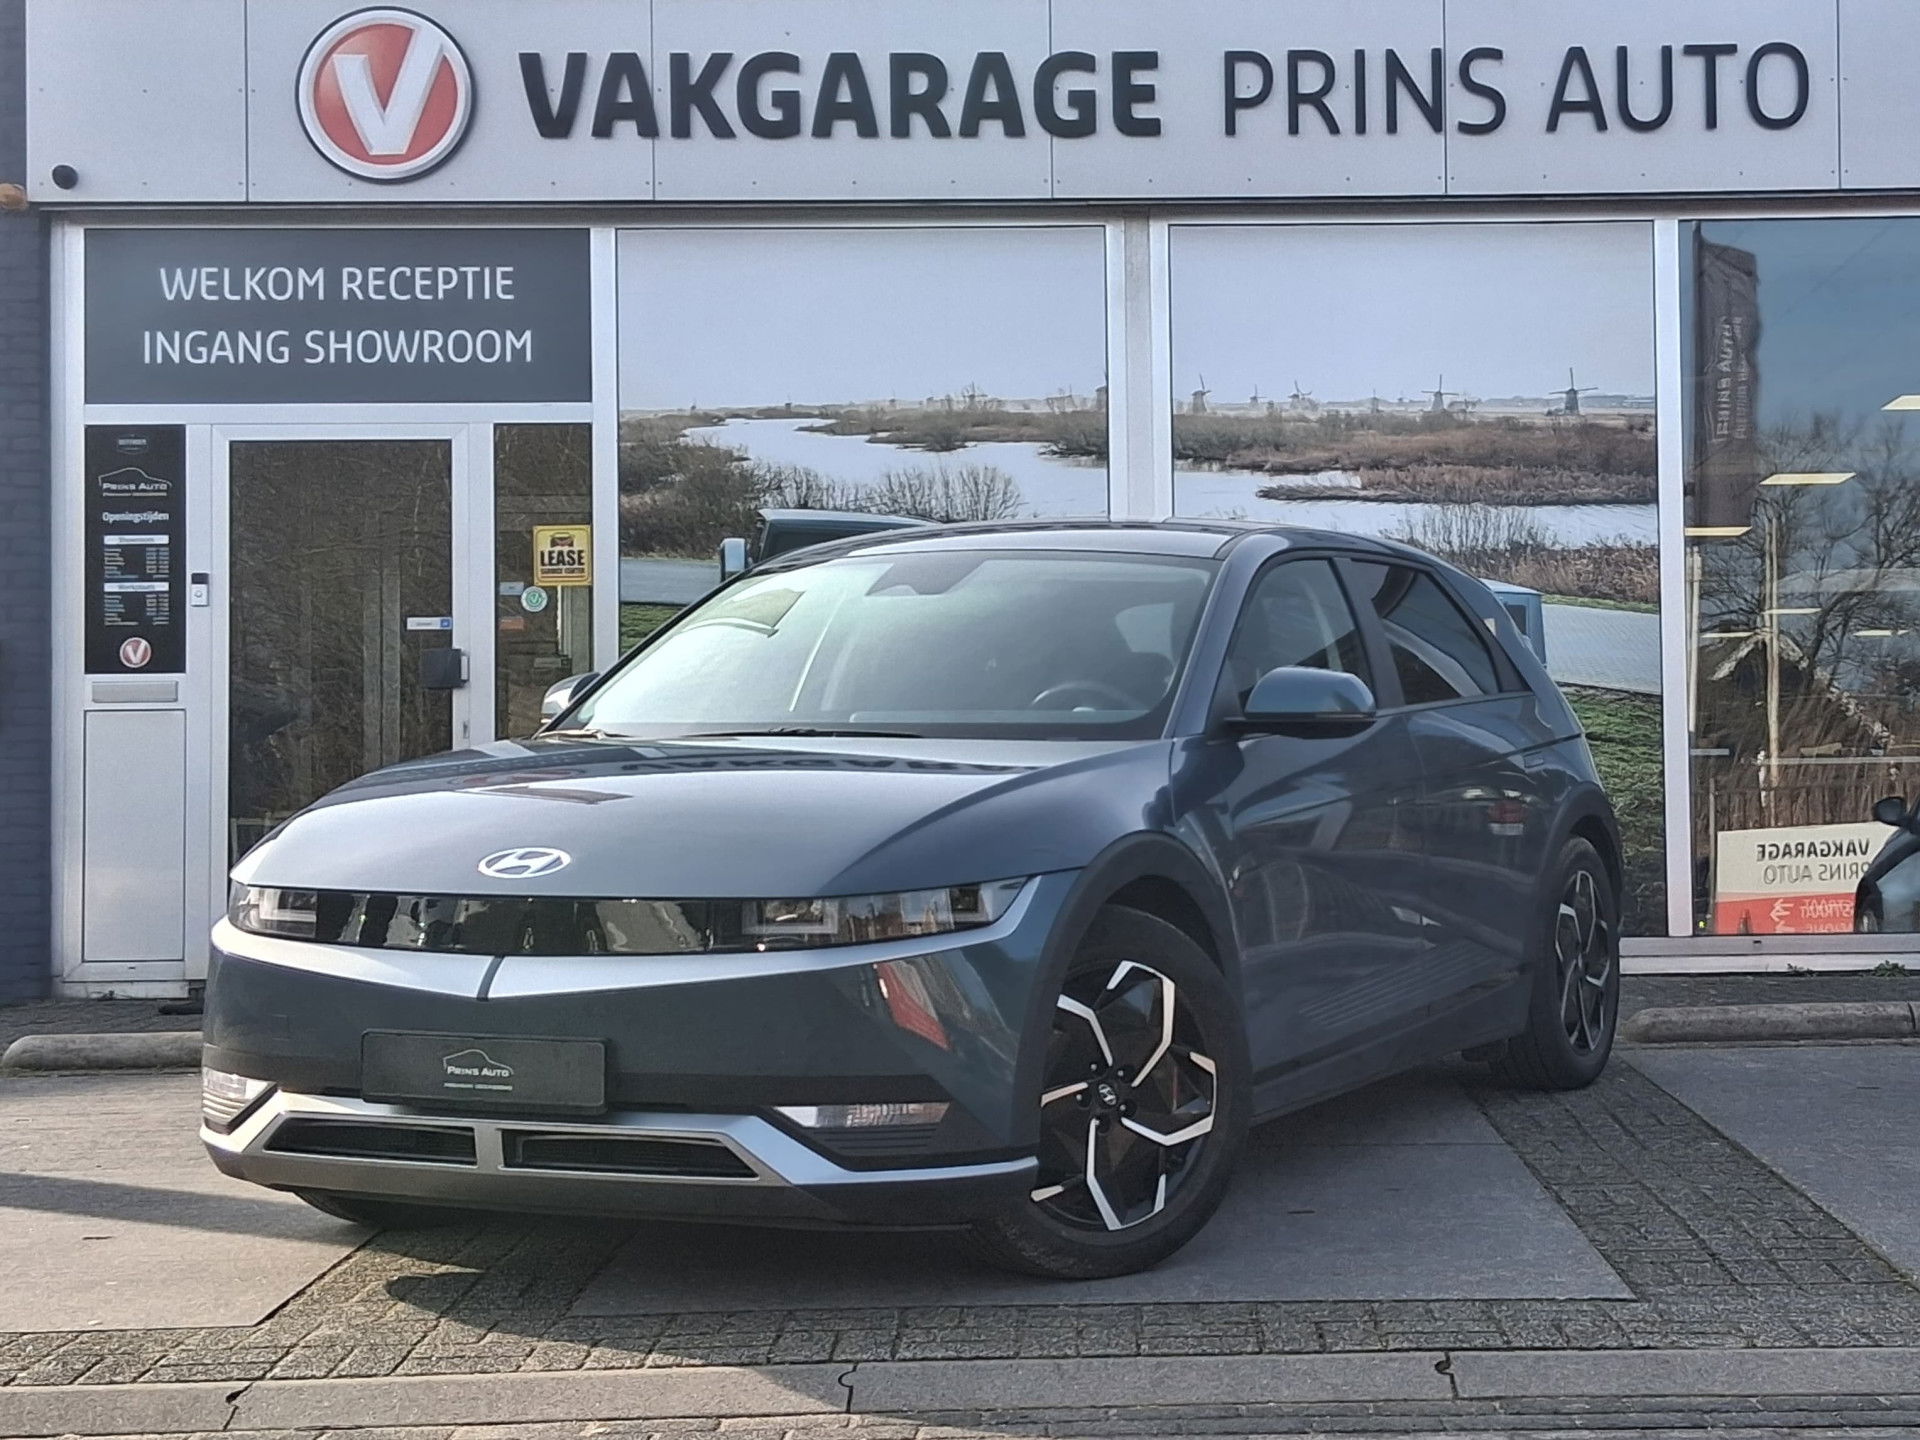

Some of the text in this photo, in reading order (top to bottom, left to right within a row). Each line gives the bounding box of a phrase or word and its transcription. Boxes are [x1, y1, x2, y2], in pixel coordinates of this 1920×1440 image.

[518, 41, 1811, 139] VAKGARAGE PRINS AUTO
[159, 266, 516, 301] WELKOM RECEPTIE
[142, 329, 533, 364] INGANG SHOWROOM
[541, 550, 585, 566] LEASE
[481, 1066, 510, 1077] AUTO
